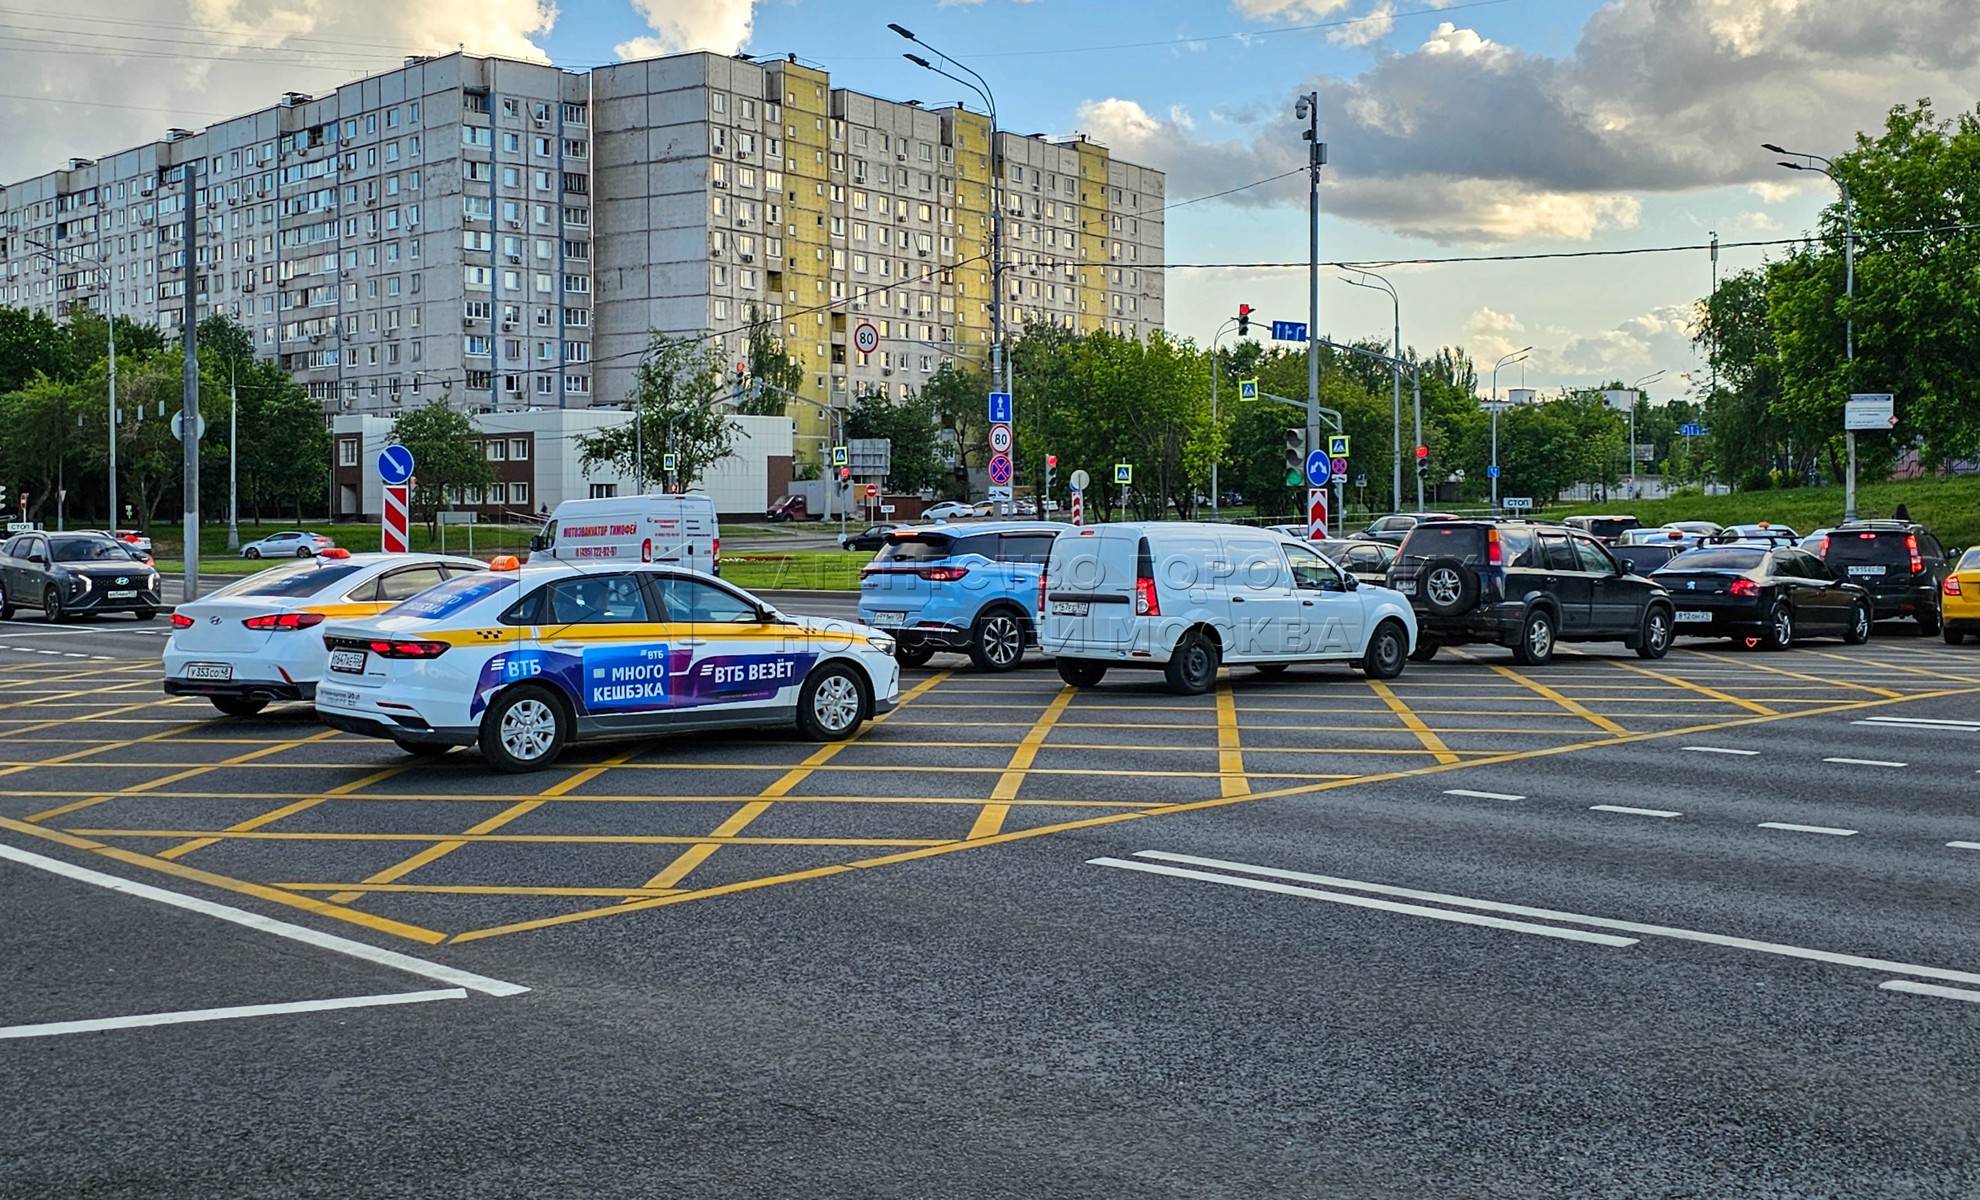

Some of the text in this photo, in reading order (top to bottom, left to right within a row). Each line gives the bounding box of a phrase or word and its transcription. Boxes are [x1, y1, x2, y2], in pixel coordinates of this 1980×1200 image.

[859, 332, 874, 345] 80
[994, 433, 1008, 445] 80
[1507, 499, 1529, 507] СТОП
[647, 650, 664, 660] ВТБ
[507, 659, 541, 677] ВТБ
[612, 664, 664, 682] МНОГО
[714, 658, 794, 683] ВТБ ВЕЗЁТ
[593, 682, 664, 702] КЕШБЭКА
